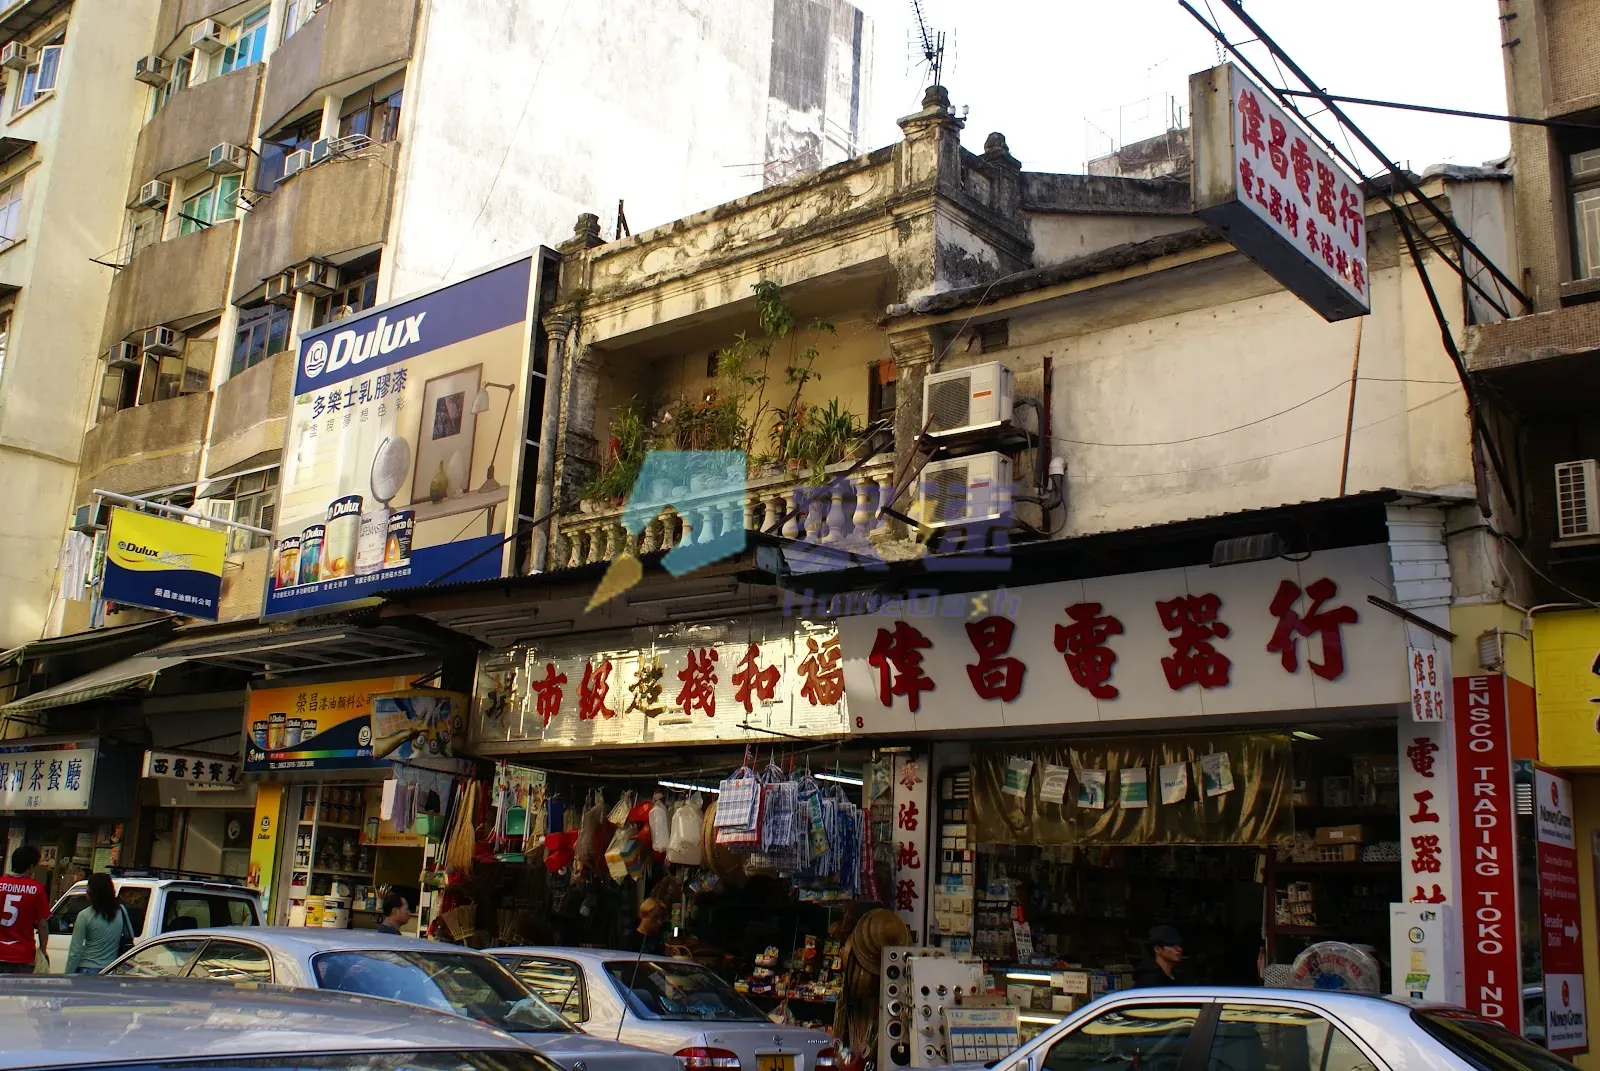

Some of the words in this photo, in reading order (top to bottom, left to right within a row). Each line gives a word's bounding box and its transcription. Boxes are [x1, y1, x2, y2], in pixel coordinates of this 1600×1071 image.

[1238, 88, 1363, 248] 偉昌電器行
[1239, 157, 1299, 238] 電工器材
[326, 312, 426, 373] Dulux
[312, 368, 408, 420] 多樂士乳膠漆
[334, 500, 360, 517] Dulux
[126, 542, 159, 557] Dulux
[868, 577, 1359, 713] 偉昌電器行
[855, 716, 864, 729] 8
[1469, 677, 1494, 753] ENSCO
[1473, 766, 1499, 876] TRADING
[1, 895, 22, 927] 5
[1476, 891, 1503, 955] TOKO
[1480, 970, 1505, 1028] IND
